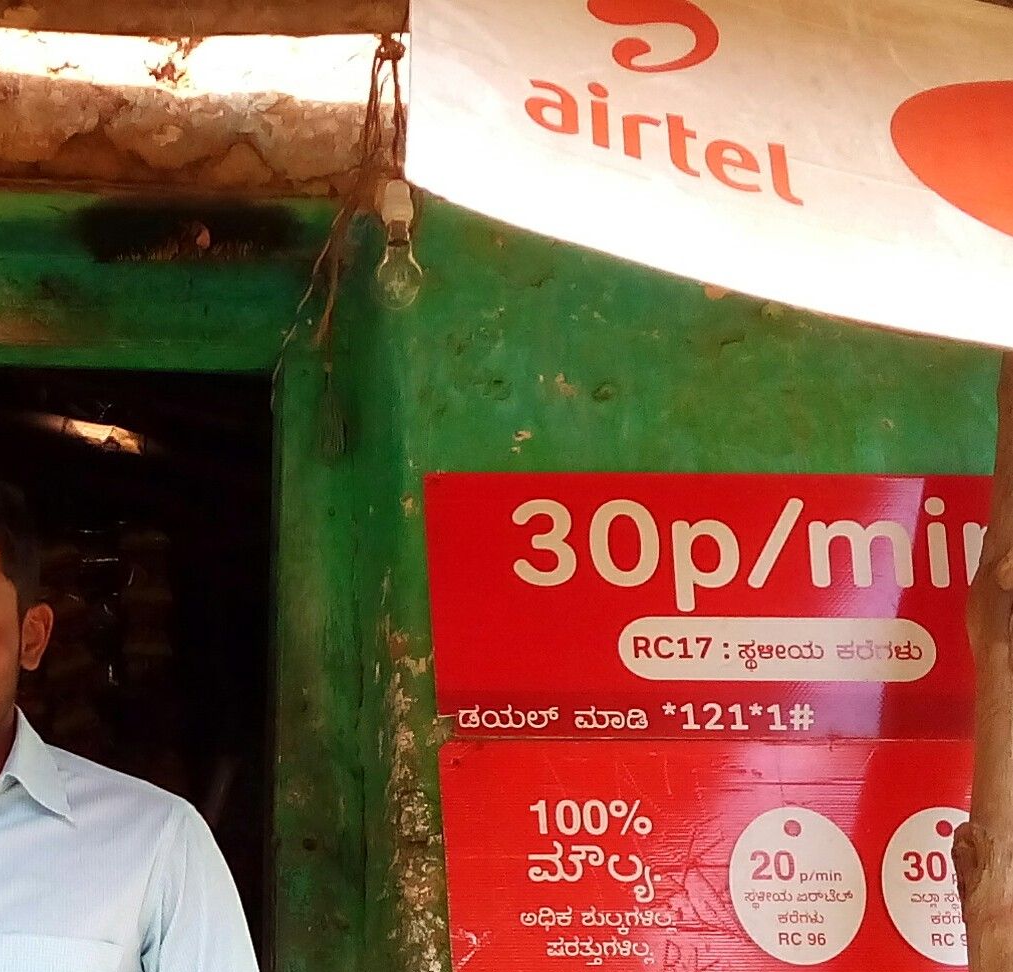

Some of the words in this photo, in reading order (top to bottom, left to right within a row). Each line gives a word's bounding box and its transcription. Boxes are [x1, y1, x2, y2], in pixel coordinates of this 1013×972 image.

[524, 79, 804, 207] airtel
[632, 636, 713, 660] RC17
[457, 705, 560, 730] ಡಯಲ್
[573, 705, 650, 730] ಮಾಡಿ
[529, 799, 653, 836] 100%
[750, 850, 796, 882] 20
[799, 871, 843, 884] p/min
[902, 851, 948, 882] 30
[519, 906, 573, 931] ಅಧಿಕ
[778, 932, 802, 946] RC
[807, 932, 827, 946] 96
[931, 933, 955, 947] RC
